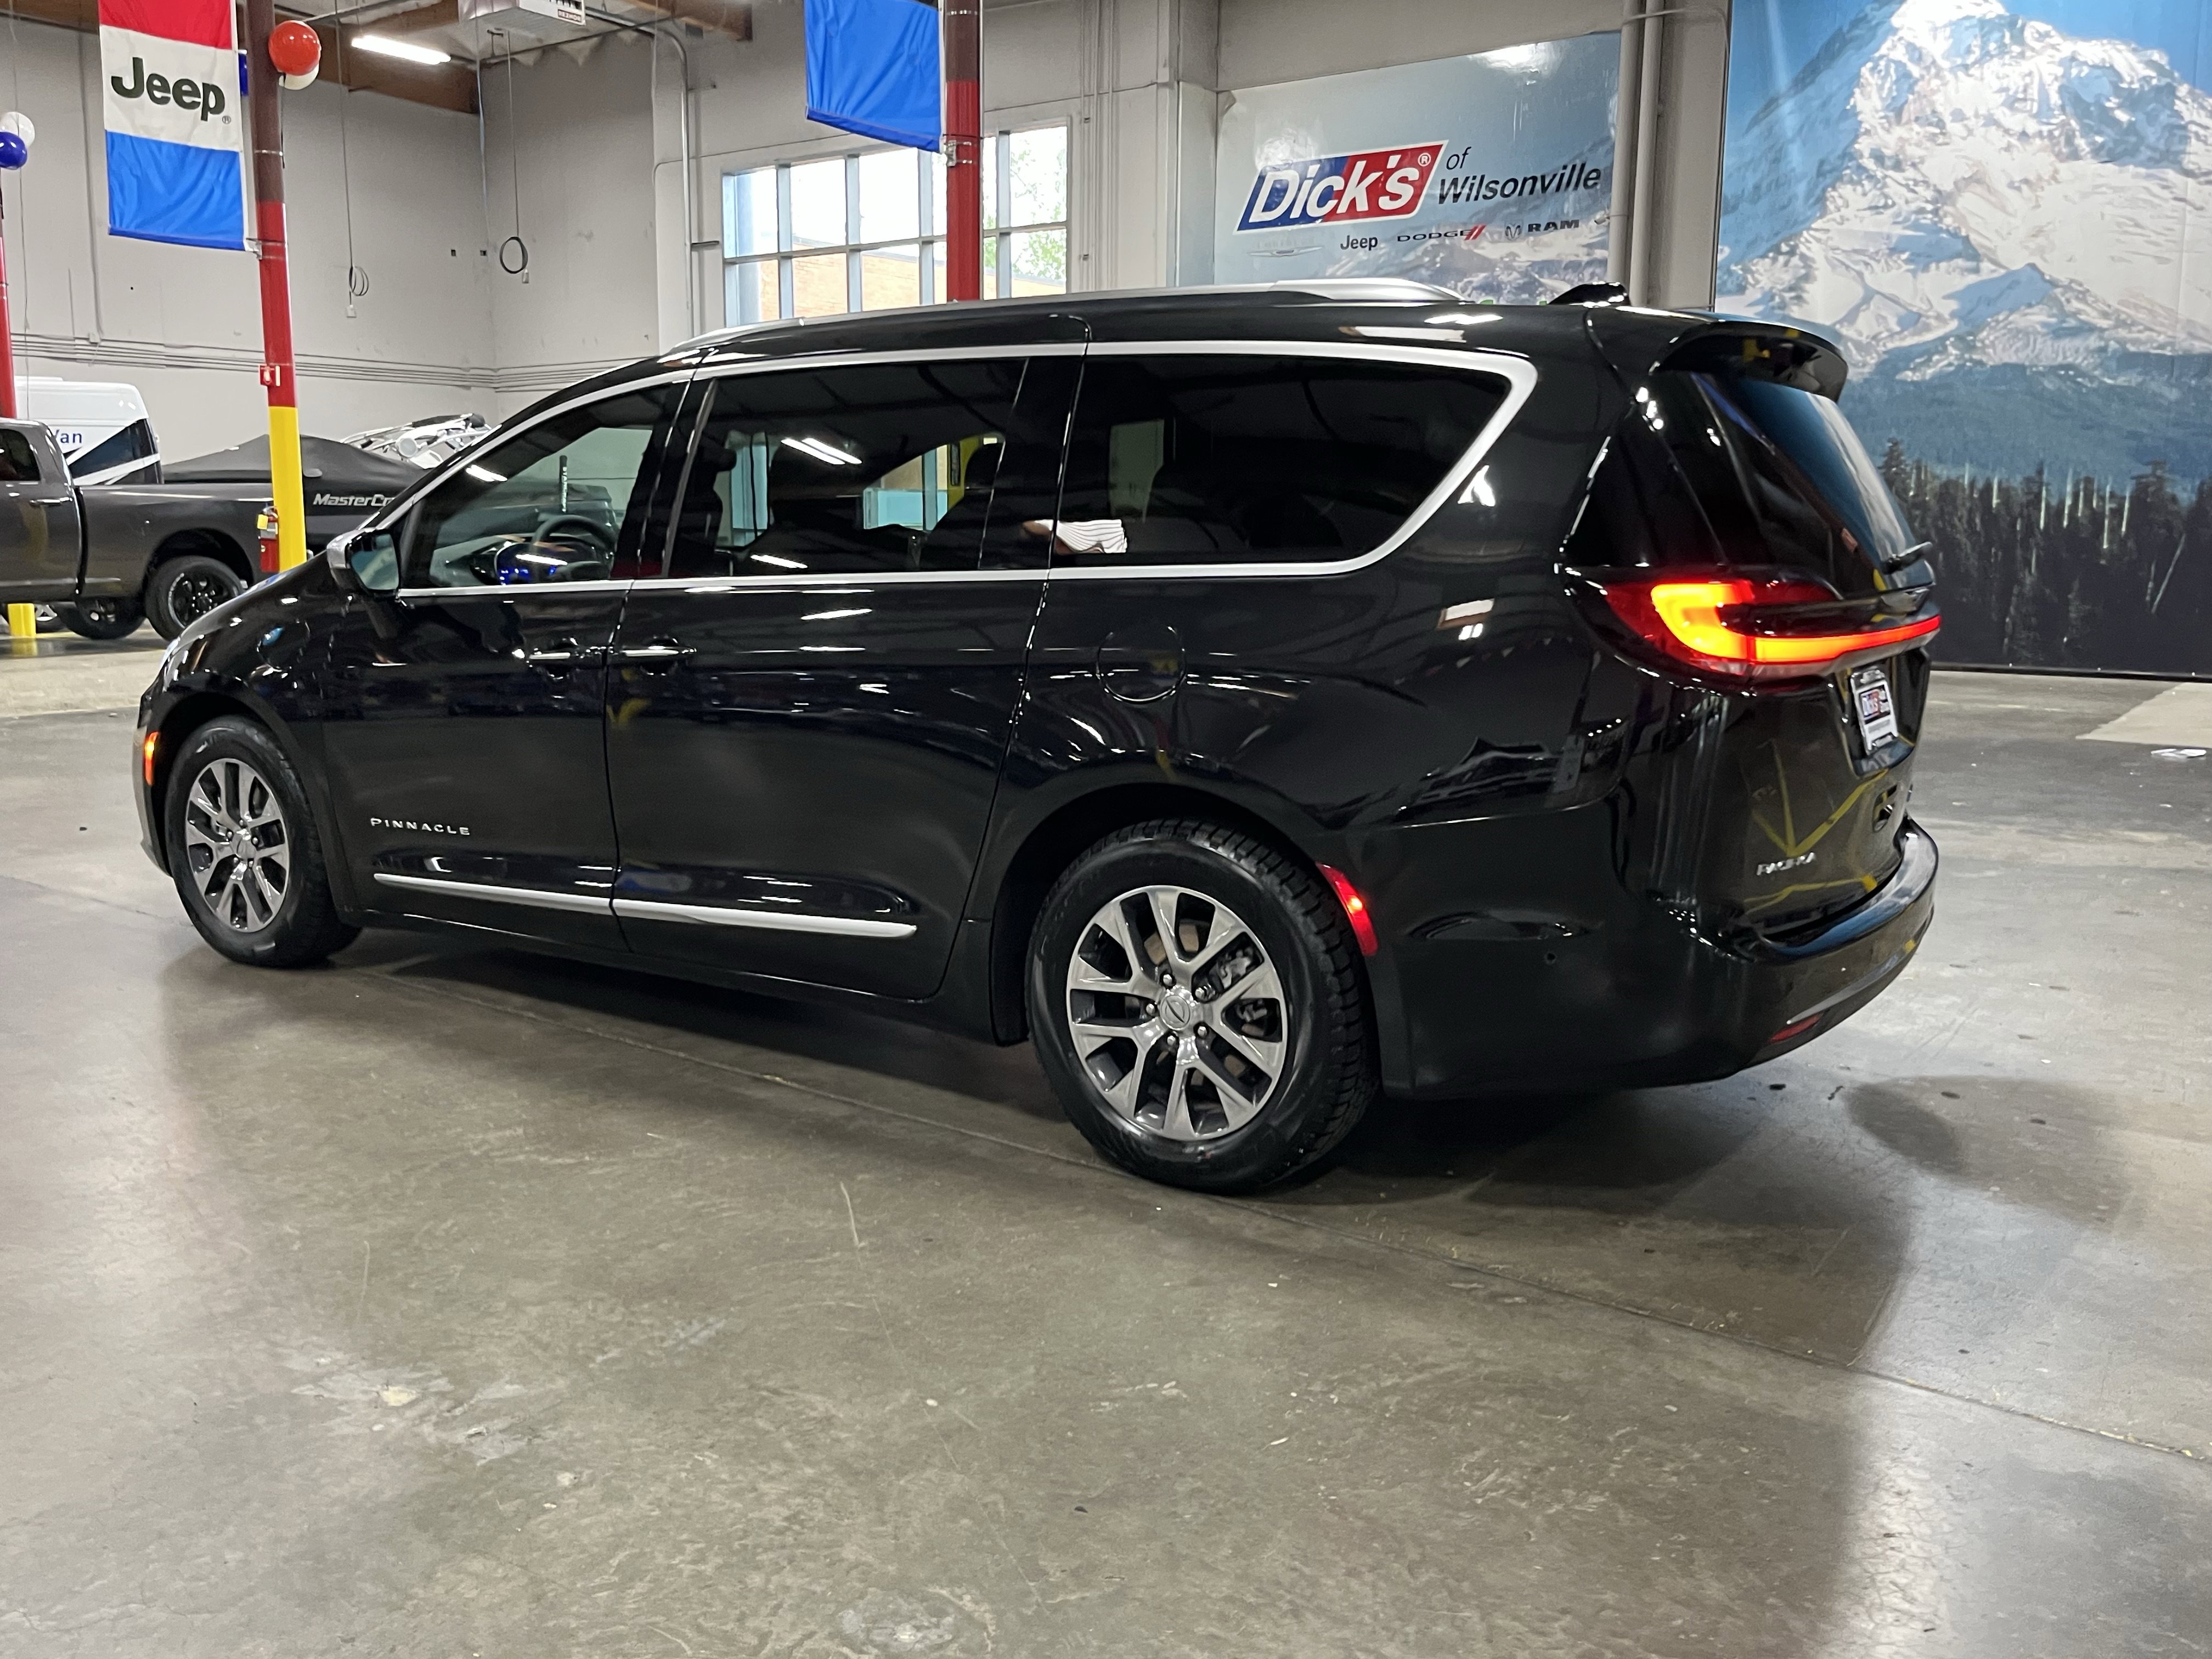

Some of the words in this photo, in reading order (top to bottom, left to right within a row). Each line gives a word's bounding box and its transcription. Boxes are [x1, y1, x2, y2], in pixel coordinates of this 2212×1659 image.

[111, 57, 225, 121] Jeep
[1446, 146, 1472, 172] of
[1438, 163, 1601, 205] Wilsonville
[1340, 234, 1378, 251] Jeep
[1397, 229, 1471, 242] DODGE
[1528, 219, 1579, 233] RAM
[55, 429, 82, 444] an
[370, 817, 471, 836] PINNACLE
